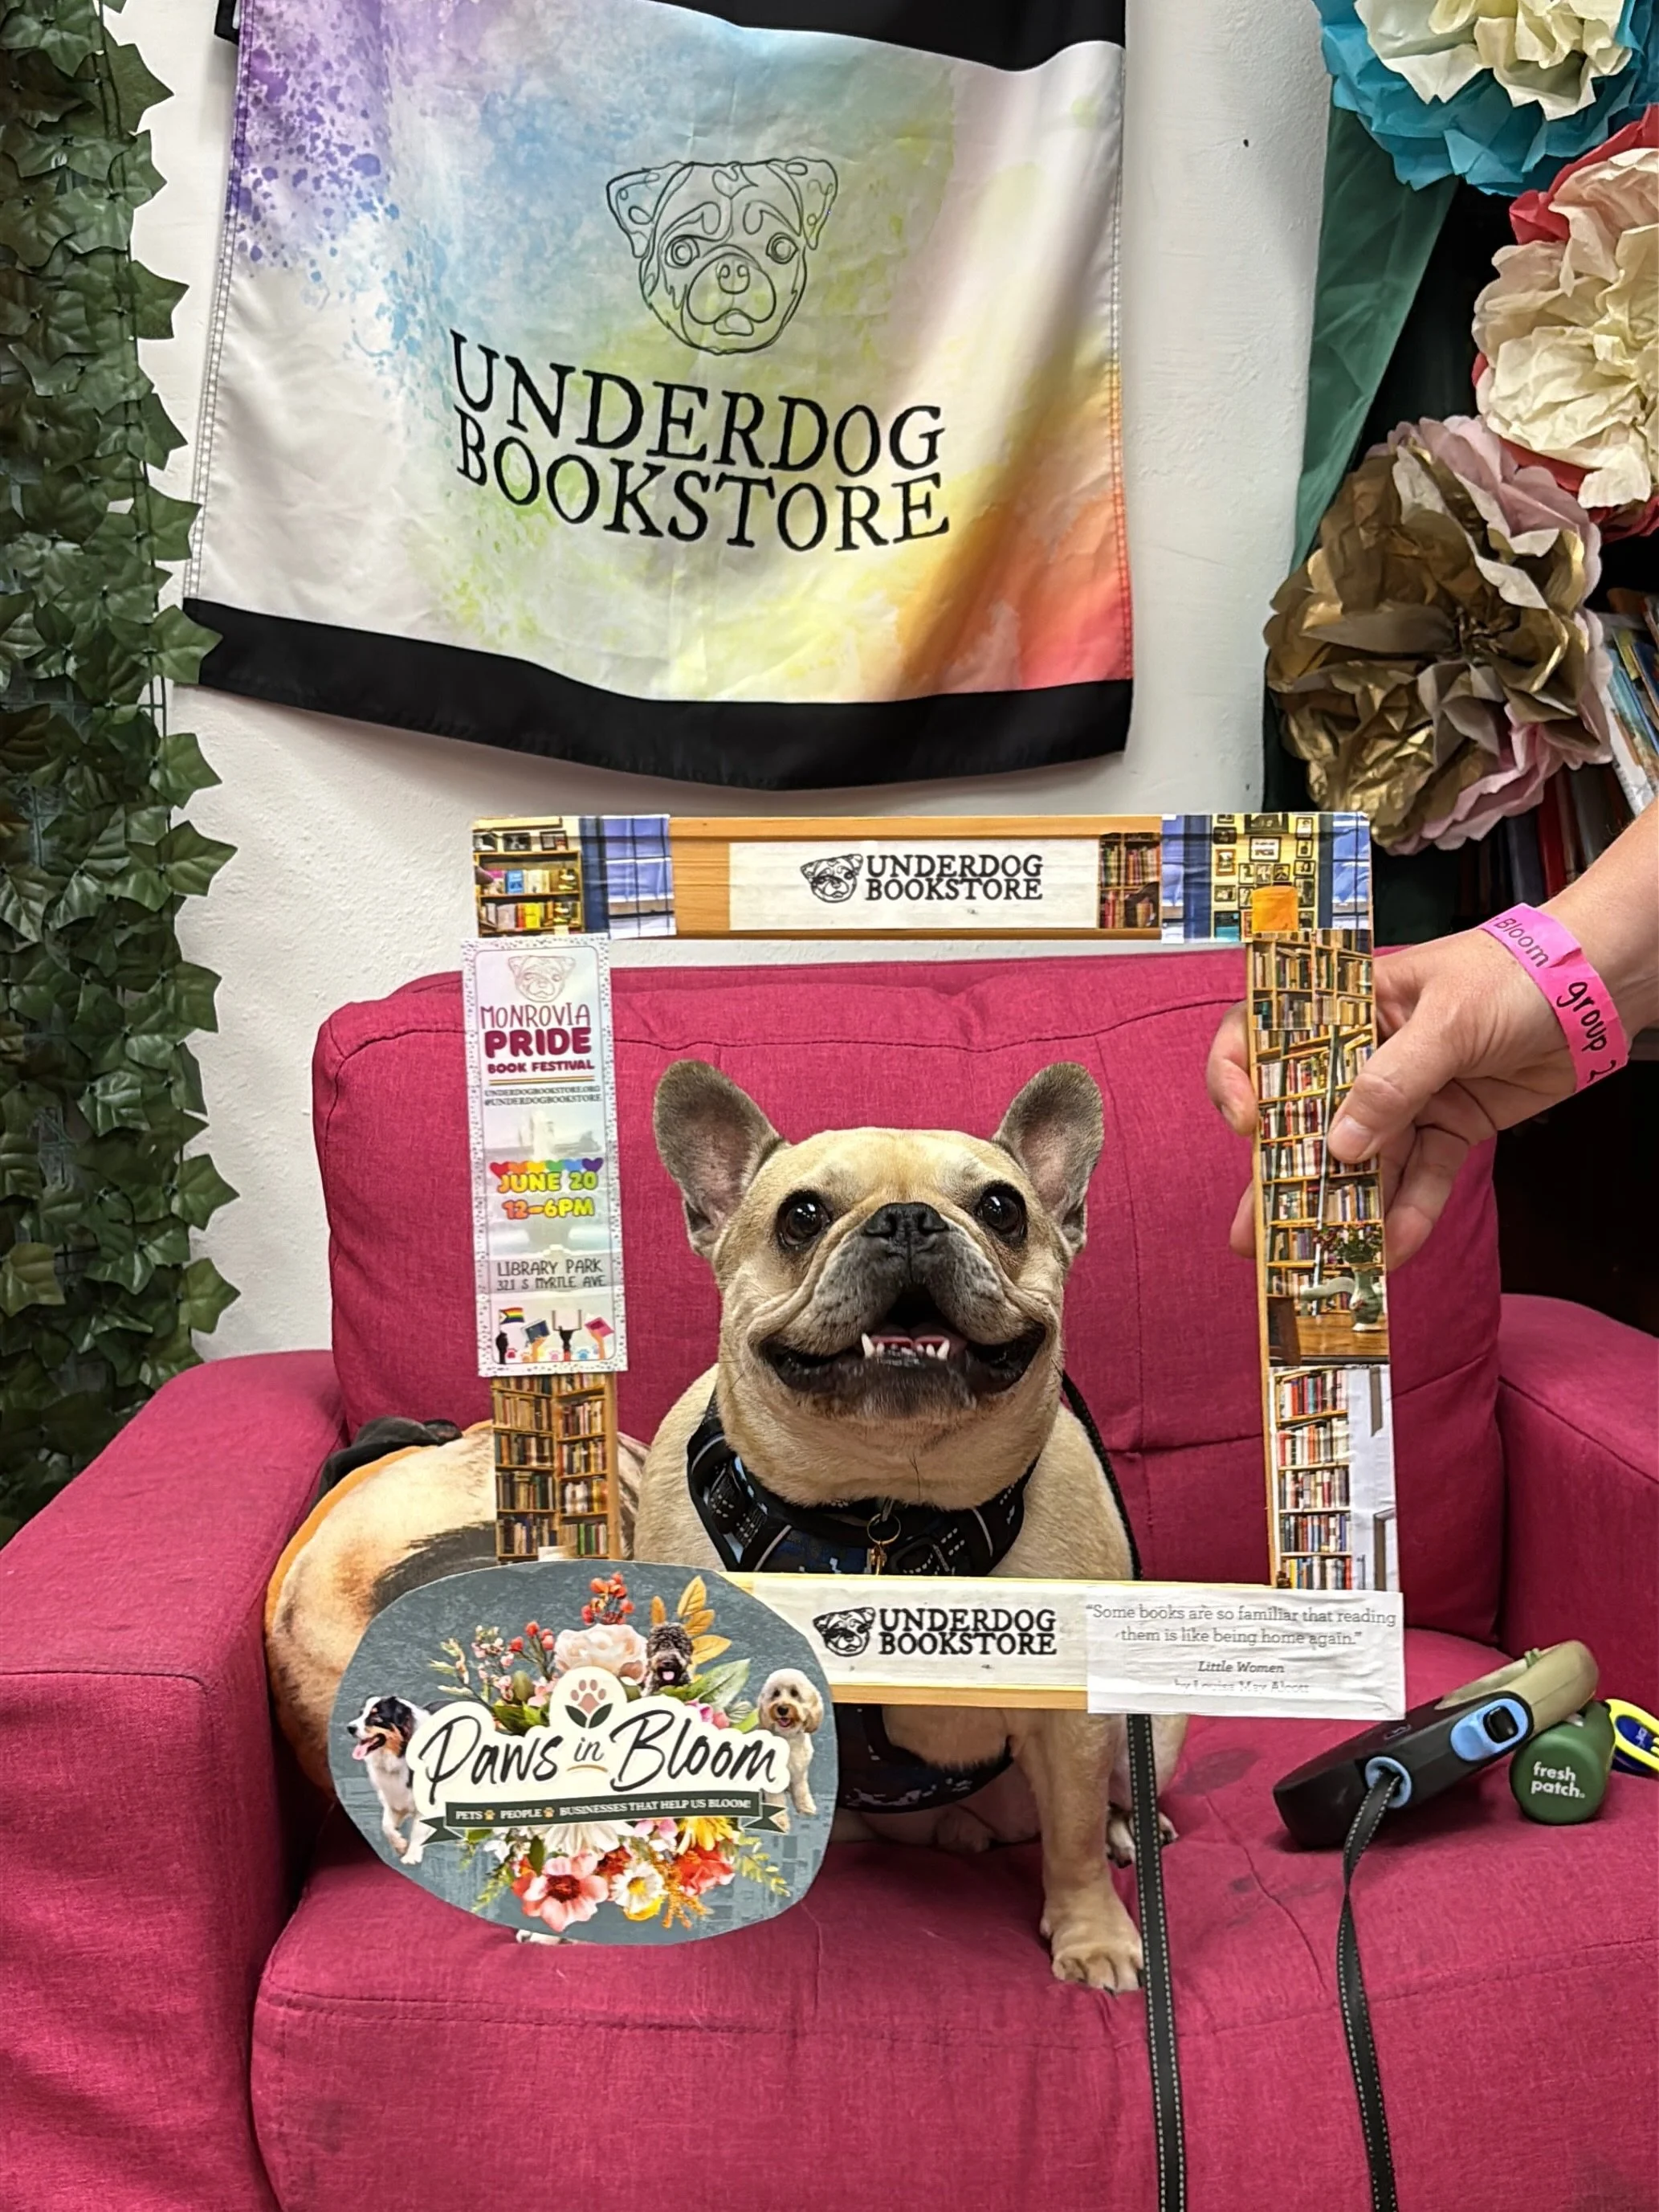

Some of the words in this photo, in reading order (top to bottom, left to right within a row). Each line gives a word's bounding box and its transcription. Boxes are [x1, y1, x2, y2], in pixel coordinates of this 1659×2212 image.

[450, 329, 945, 477] UNDERDOG
[454, 404, 949, 552] BOOKSTORE
[866, 854, 1043, 878] UNDERDOG
[865, 877, 1043, 900] BOOKSTORE
[1494, 917, 1550, 968] Bloom
[1555, 981, 1608, 1052] group
[480, 1002, 591, 1029] MONROVIA
[484, 1026, 592, 1059] PRIDE
[487, 1061, 527, 1075] BOOK
[531, 1059, 595, 1073] FESTIVAL
[497, 1172, 560, 1194] JUNE
[569, 1170, 599, 1190] 20
[496, 1261, 559, 1277] LIBRARY
[565, 1258, 603, 1275] PARK
[496, 1279, 516, 1292] 321
[521, 1278, 530, 1290] S
[535, 1277, 576, 1290] MYRTLE
[583, 1275, 606, 1288] AVE
[879, 1608, 1057, 1632] UNDERDOG
[1139, 1604, 1185, 1619] books
[1188, 1606, 1213, 1620] are
[1217, 1609, 1234, 1620] so
[1239, 1606, 1298, 1622] familiar
[1302, 1607, 1333, 1622] that
[1337, 1608, 1396, 1627] reading
[878, 1631, 1058, 1655] BOOKSTORE
[1121, 1626, 1160, 1642] them
[1164, 1629, 1177, 1642] is
[1181, 1627, 1209, 1643] like
[1213, 1627, 1257, 1647] being
[1262, 1629, 1306, 1644] home
[1198, 1660, 1233, 1672] Little
[1237, 1662, 1286, 1673] Women
[418, 1716, 565, 1806] Paws
[574, 1737, 605, 1762] in
[609, 1712, 777, 1792] Bloom
[1533, 1761, 1576, 1782] fresh
[454, 1810, 483, 1821] PETS
[500, 1809, 542, 1819] PEOPLE
[560, 1803, 627, 1817] BUSINESSES
[628, 1802, 658, 1811] THAT
[660, 1800, 688, 1810] HELP
[690, 1799, 706, 1809] US
[707, 1798, 751, 1809] BLOOM!
